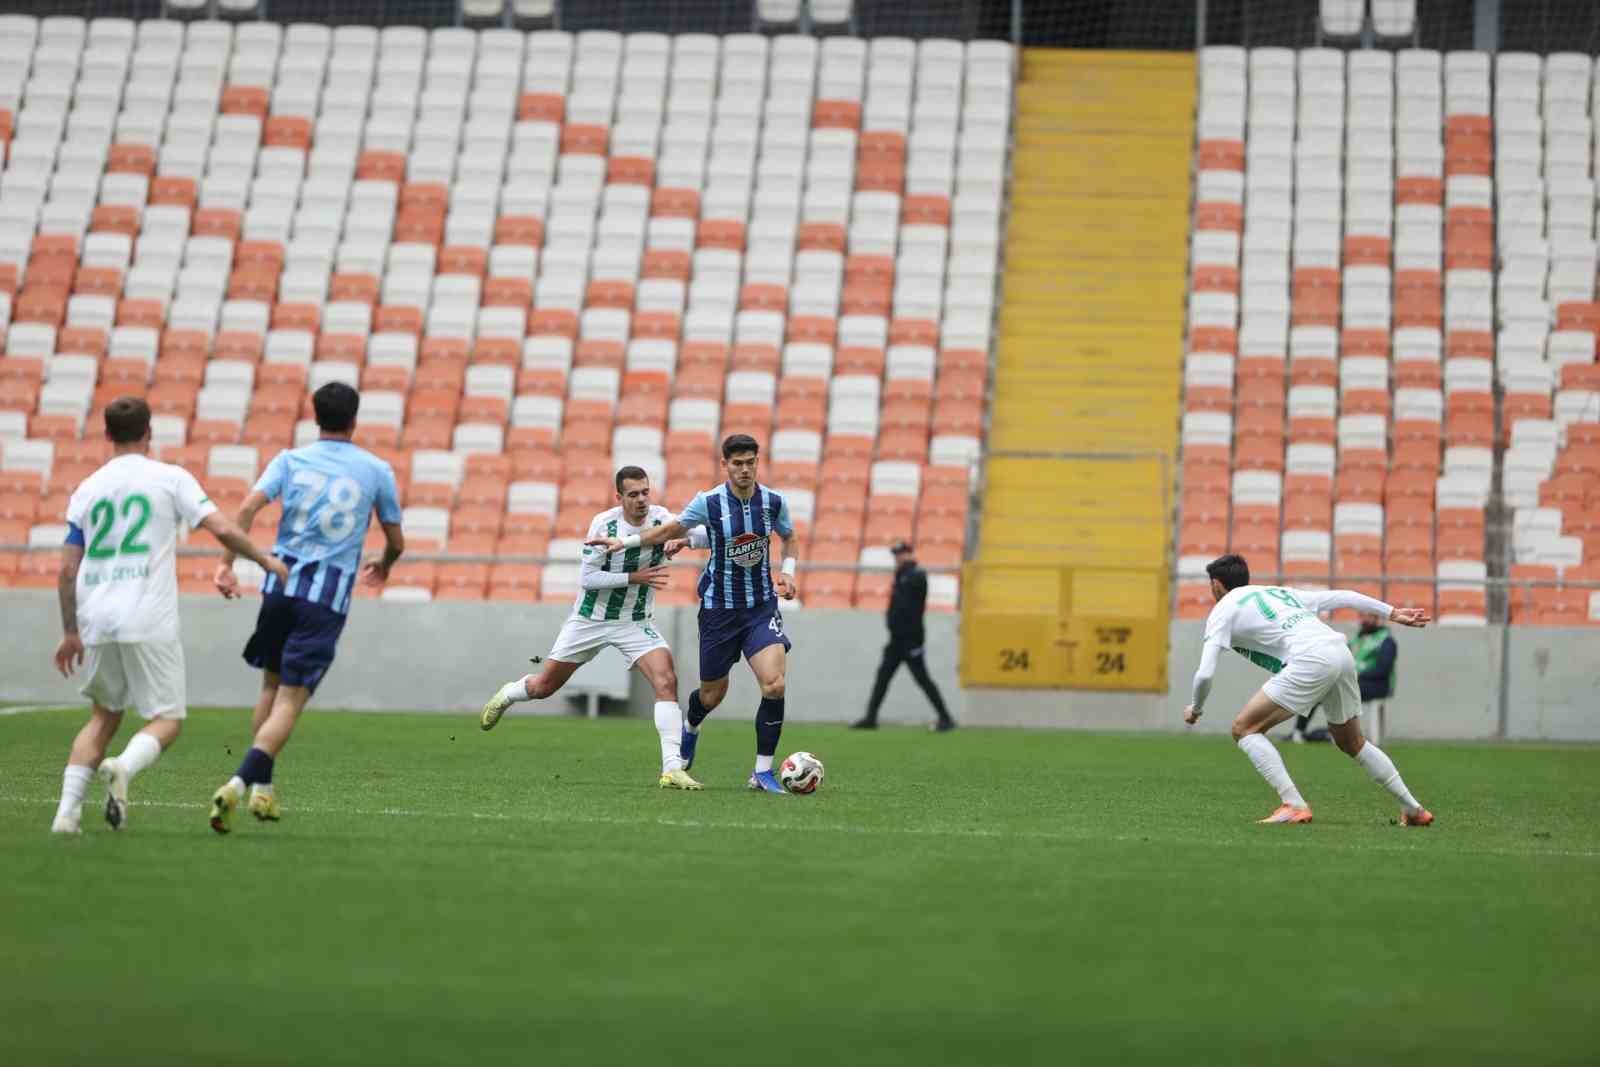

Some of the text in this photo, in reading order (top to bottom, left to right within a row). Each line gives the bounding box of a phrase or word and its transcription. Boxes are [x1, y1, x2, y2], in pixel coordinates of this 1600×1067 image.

[87, 494, 152, 559] 22
[292, 470, 362, 542] 78
[999, 650, 1029, 671] 24
[1096, 652, 1125, 674] 24
